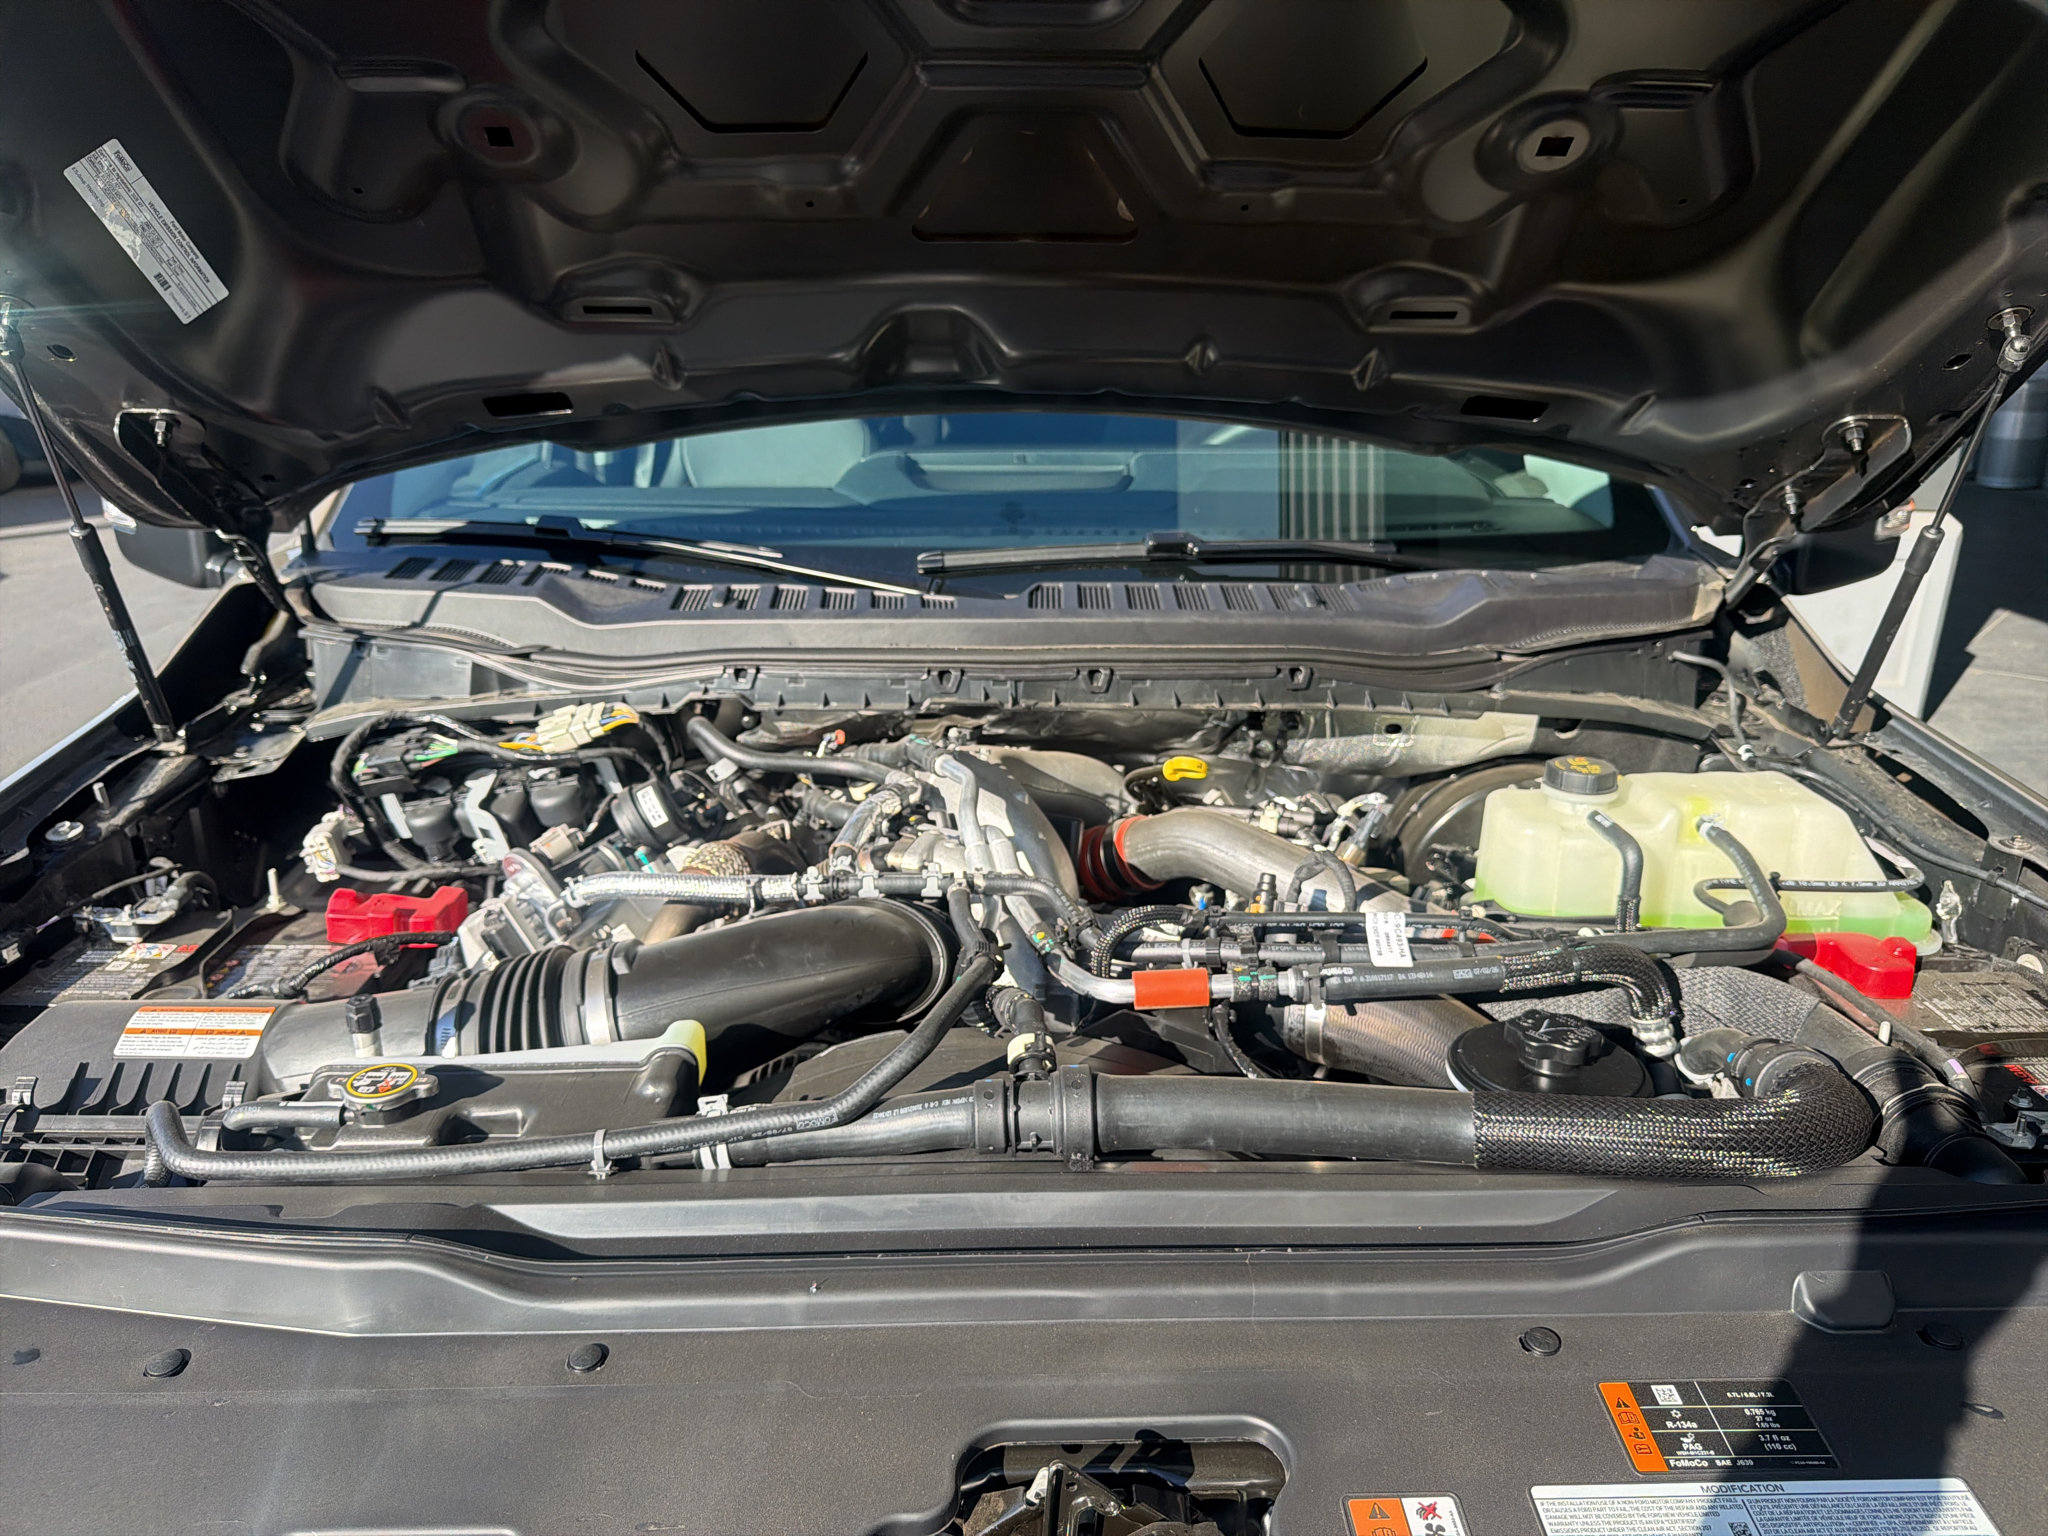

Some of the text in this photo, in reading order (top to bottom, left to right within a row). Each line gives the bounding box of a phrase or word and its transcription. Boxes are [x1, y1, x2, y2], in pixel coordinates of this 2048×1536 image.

[146, 200, 163, 220] VEHICLE
[183, 241, 200, 260] Company
[1744, 1408, 1764, 1416] 0.765
[1758, 1434, 1770, 1442] 3.7
[1772, 1434, 1779, 1442] fl
[1764, 1443, 1797, 1451] (110 cc)
[1669, 1459, 1708, 1467] FoMoCo
[1700, 1484, 1785, 1493] MODIFICATION
